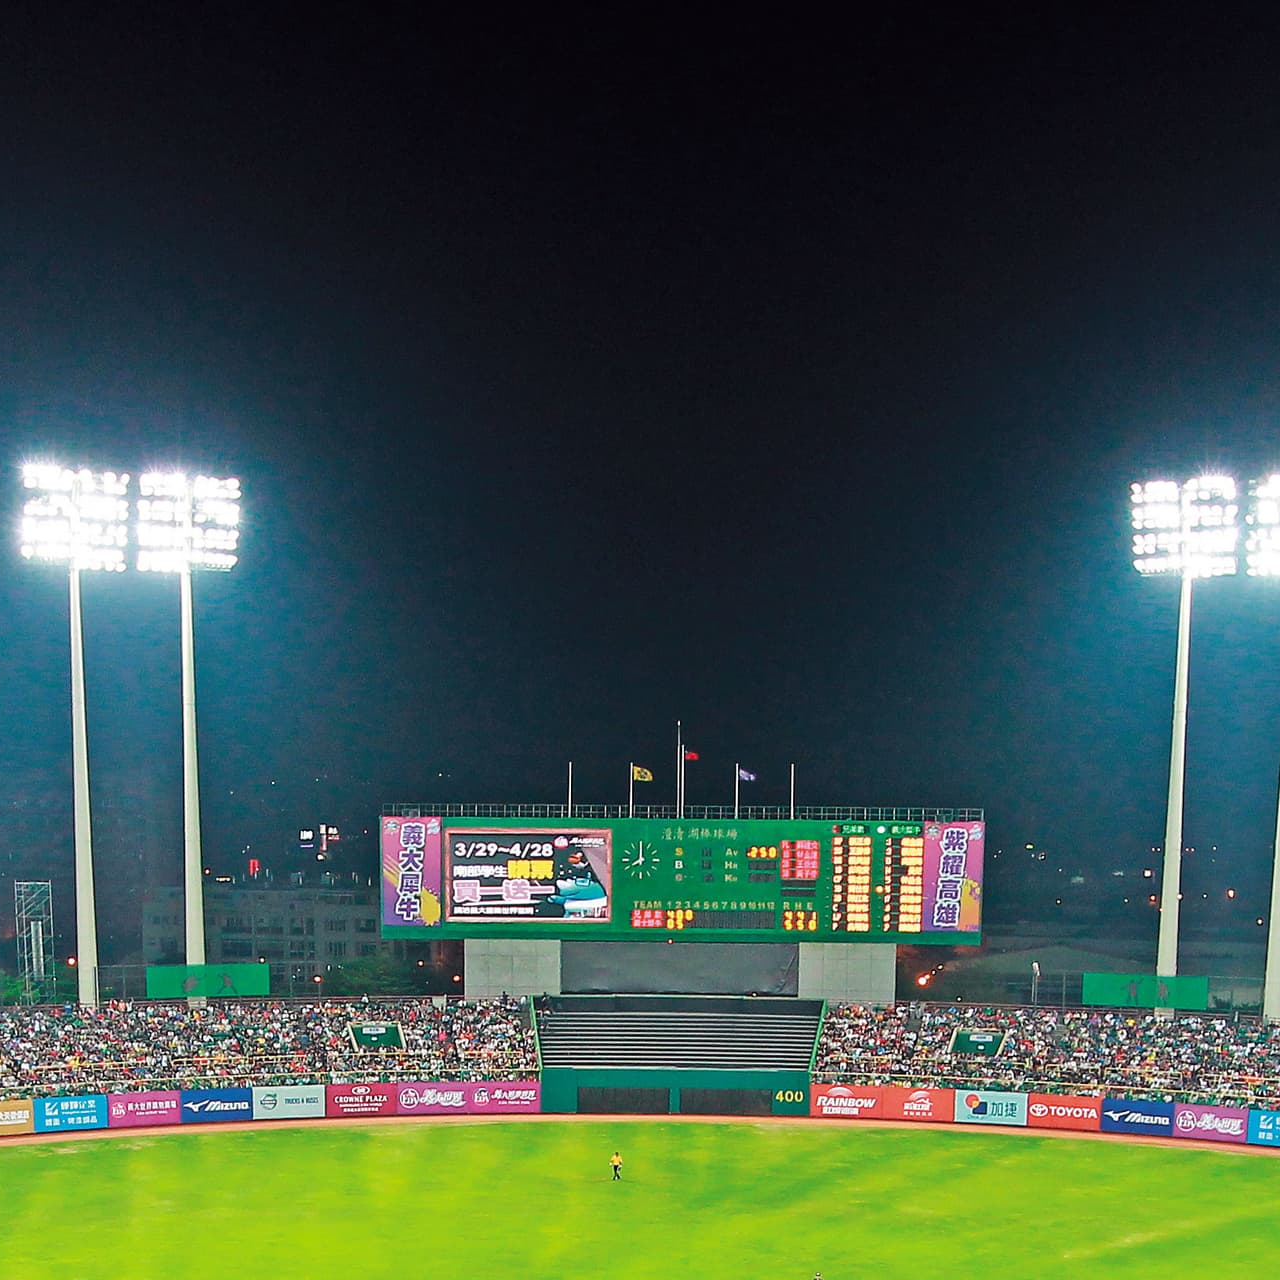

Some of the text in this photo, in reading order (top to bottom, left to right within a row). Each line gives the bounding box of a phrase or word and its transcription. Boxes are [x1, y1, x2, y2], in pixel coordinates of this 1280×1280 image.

[662, 826, 738, 840] 澄清湖棒球場
[454, 843, 553, 858] 3/29~4/28
[396, 822, 425, 921] 義大犀牛
[675, 861, 683, 869] B
[932, 828, 967, 927] 紫耀高雄
[453, 880, 555, 902] 買一送一
[633, 901, 662, 909] TEAM
[334, 1095, 388, 1104] CROWNE PLAZA
[775, 1091, 804, 1102] 400
[816, 1096, 876, 1108] RAINBOW
[990, 1102, 1017, 1118] 加捷
[1049, 1105, 1098, 1119] TOYOTA
